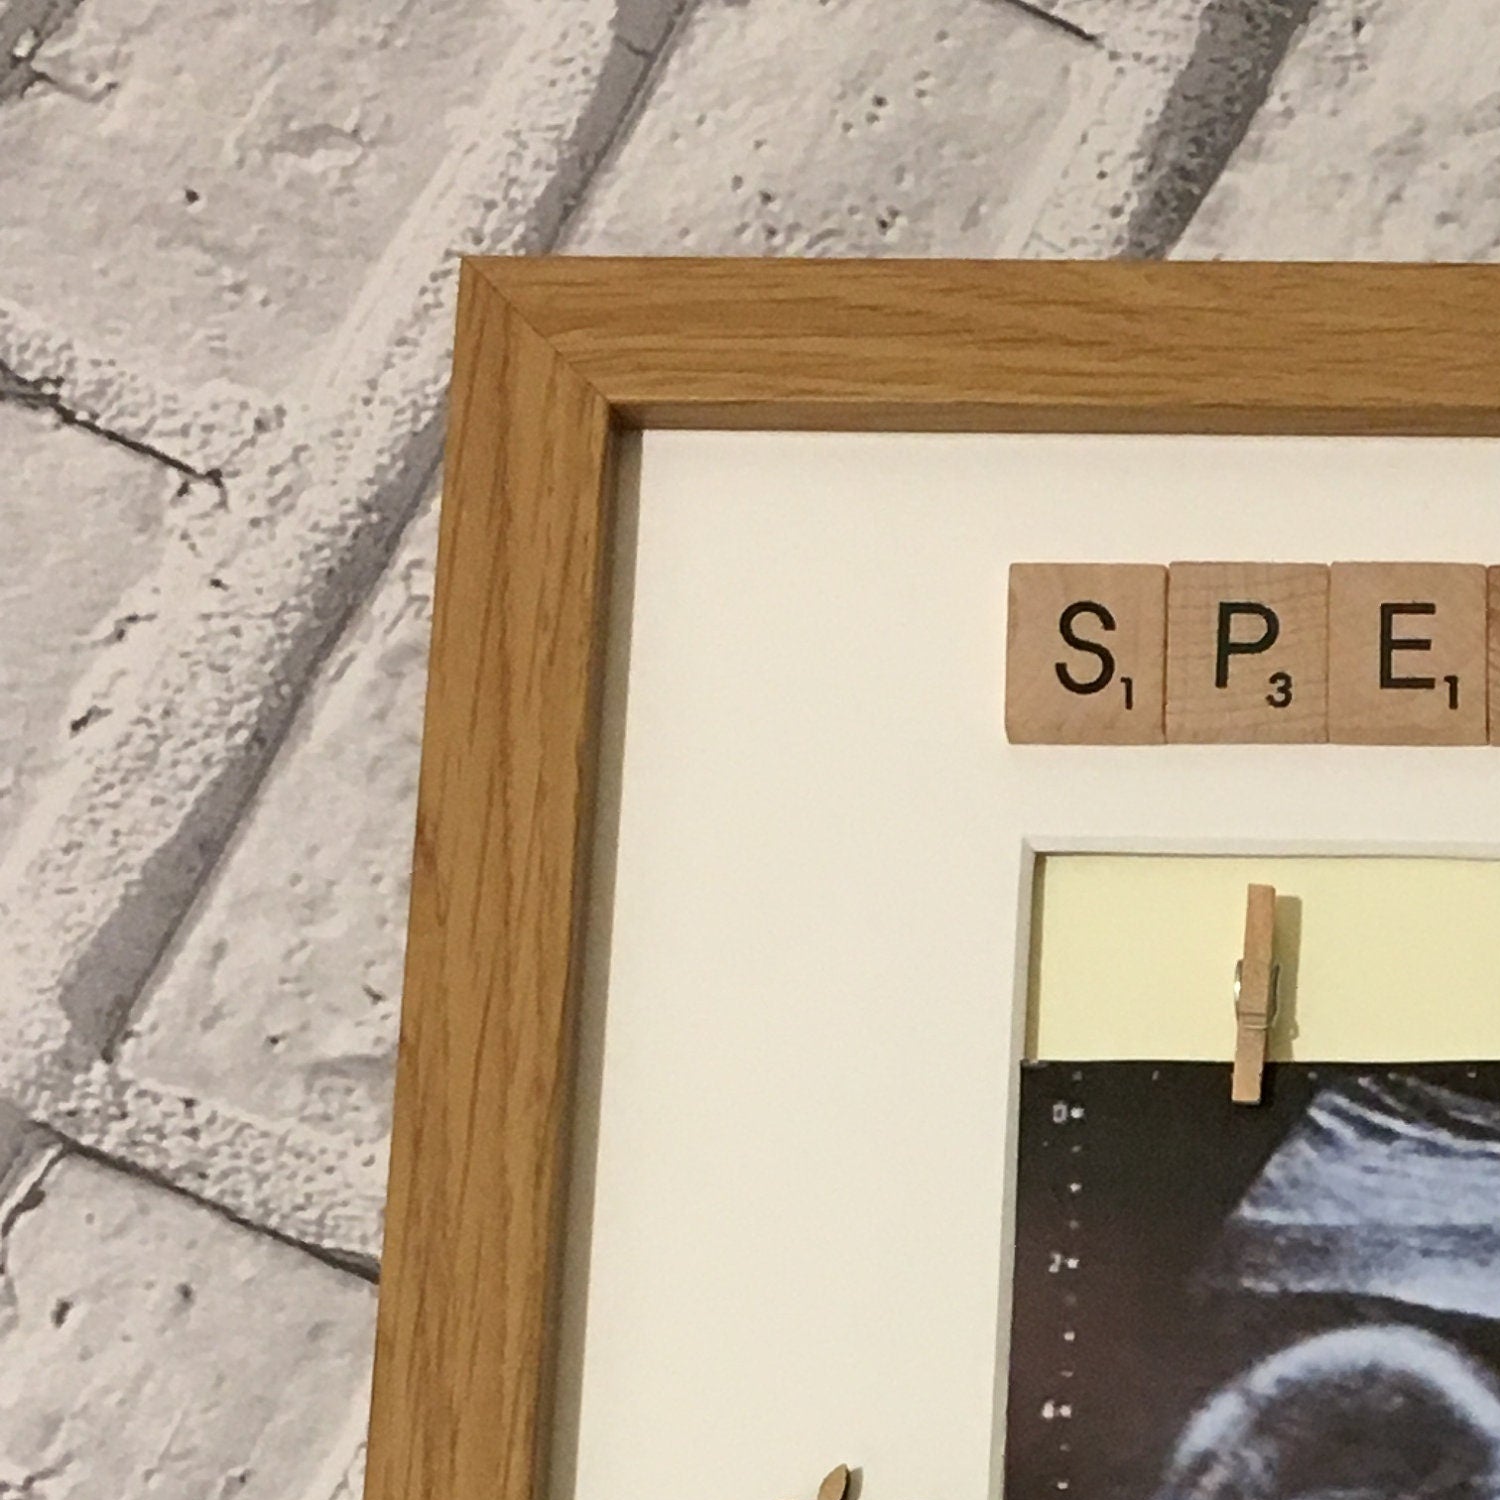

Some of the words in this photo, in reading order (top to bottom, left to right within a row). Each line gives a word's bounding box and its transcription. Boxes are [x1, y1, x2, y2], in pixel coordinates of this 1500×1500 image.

[1119, 676, 1134, 711] 1
[1264, 671, 1294, 709] 3
[1442, 674, 1460, 711] 1
